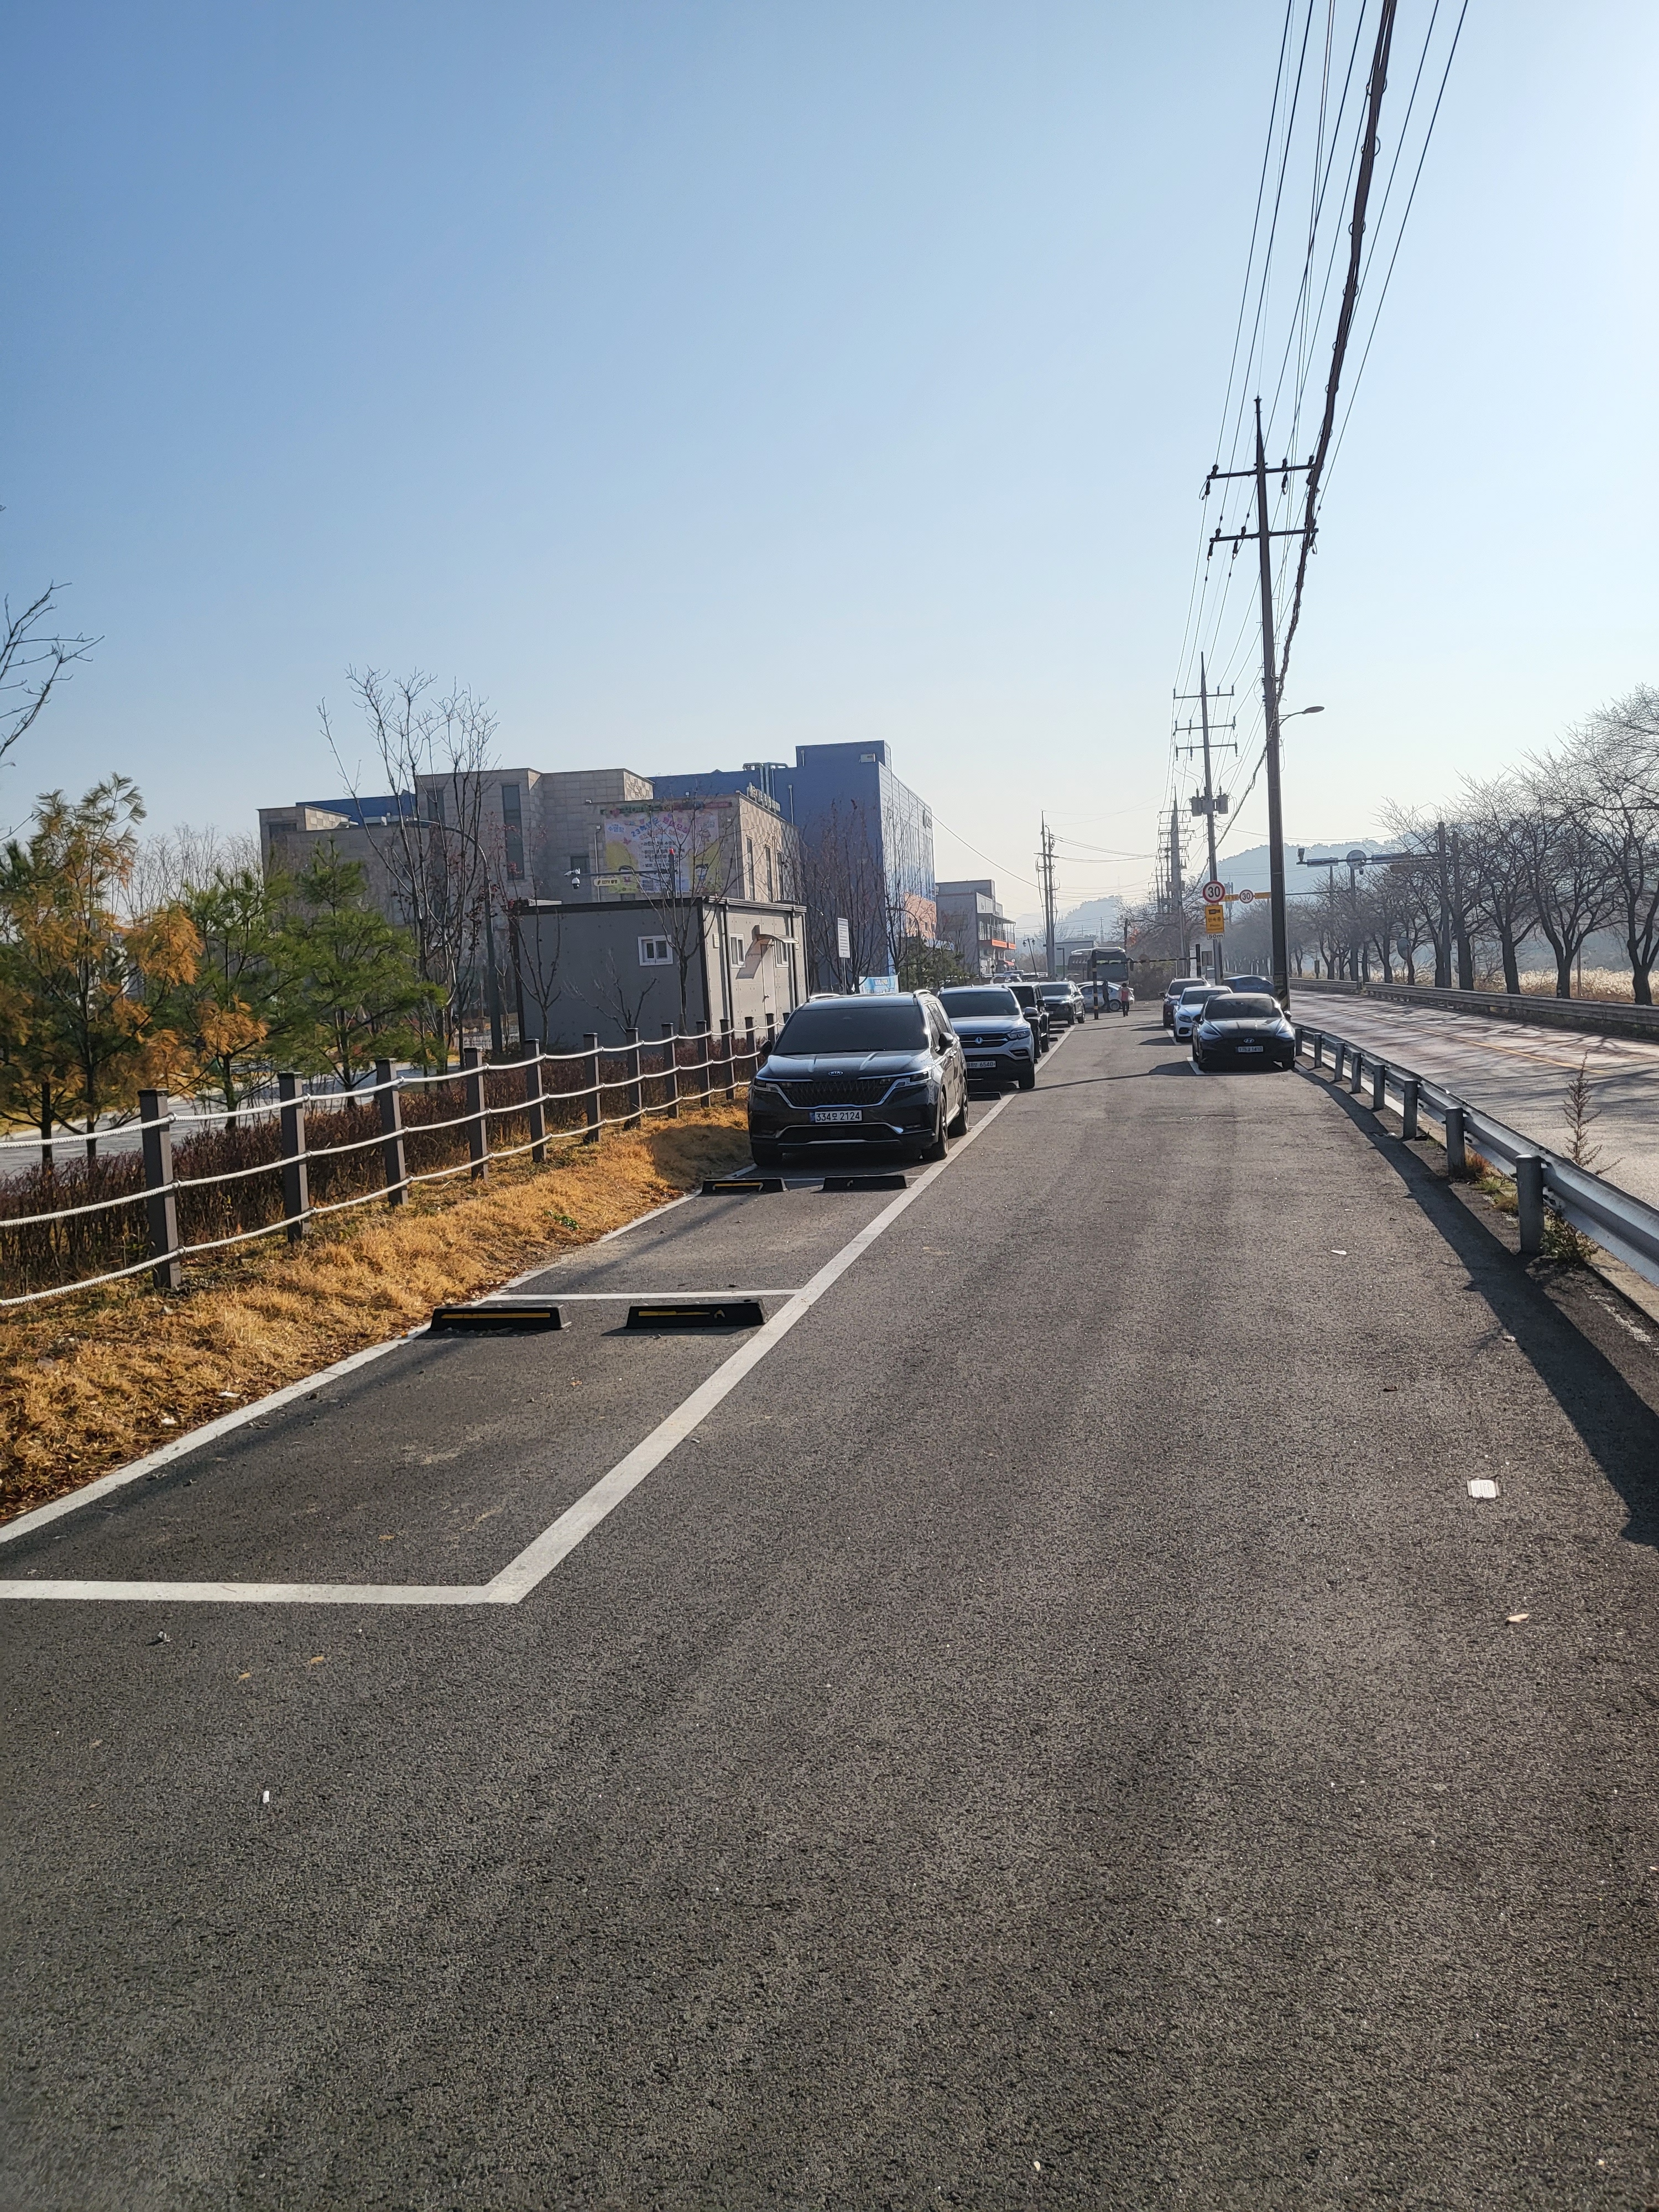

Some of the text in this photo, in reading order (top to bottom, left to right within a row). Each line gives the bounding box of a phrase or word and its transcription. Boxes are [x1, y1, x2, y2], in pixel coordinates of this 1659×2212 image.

[1208, 886, 1220, 898] 30
[1242, 892, 1251, 900] 30
[816, 1112, 859, 1121] 334모 2124
